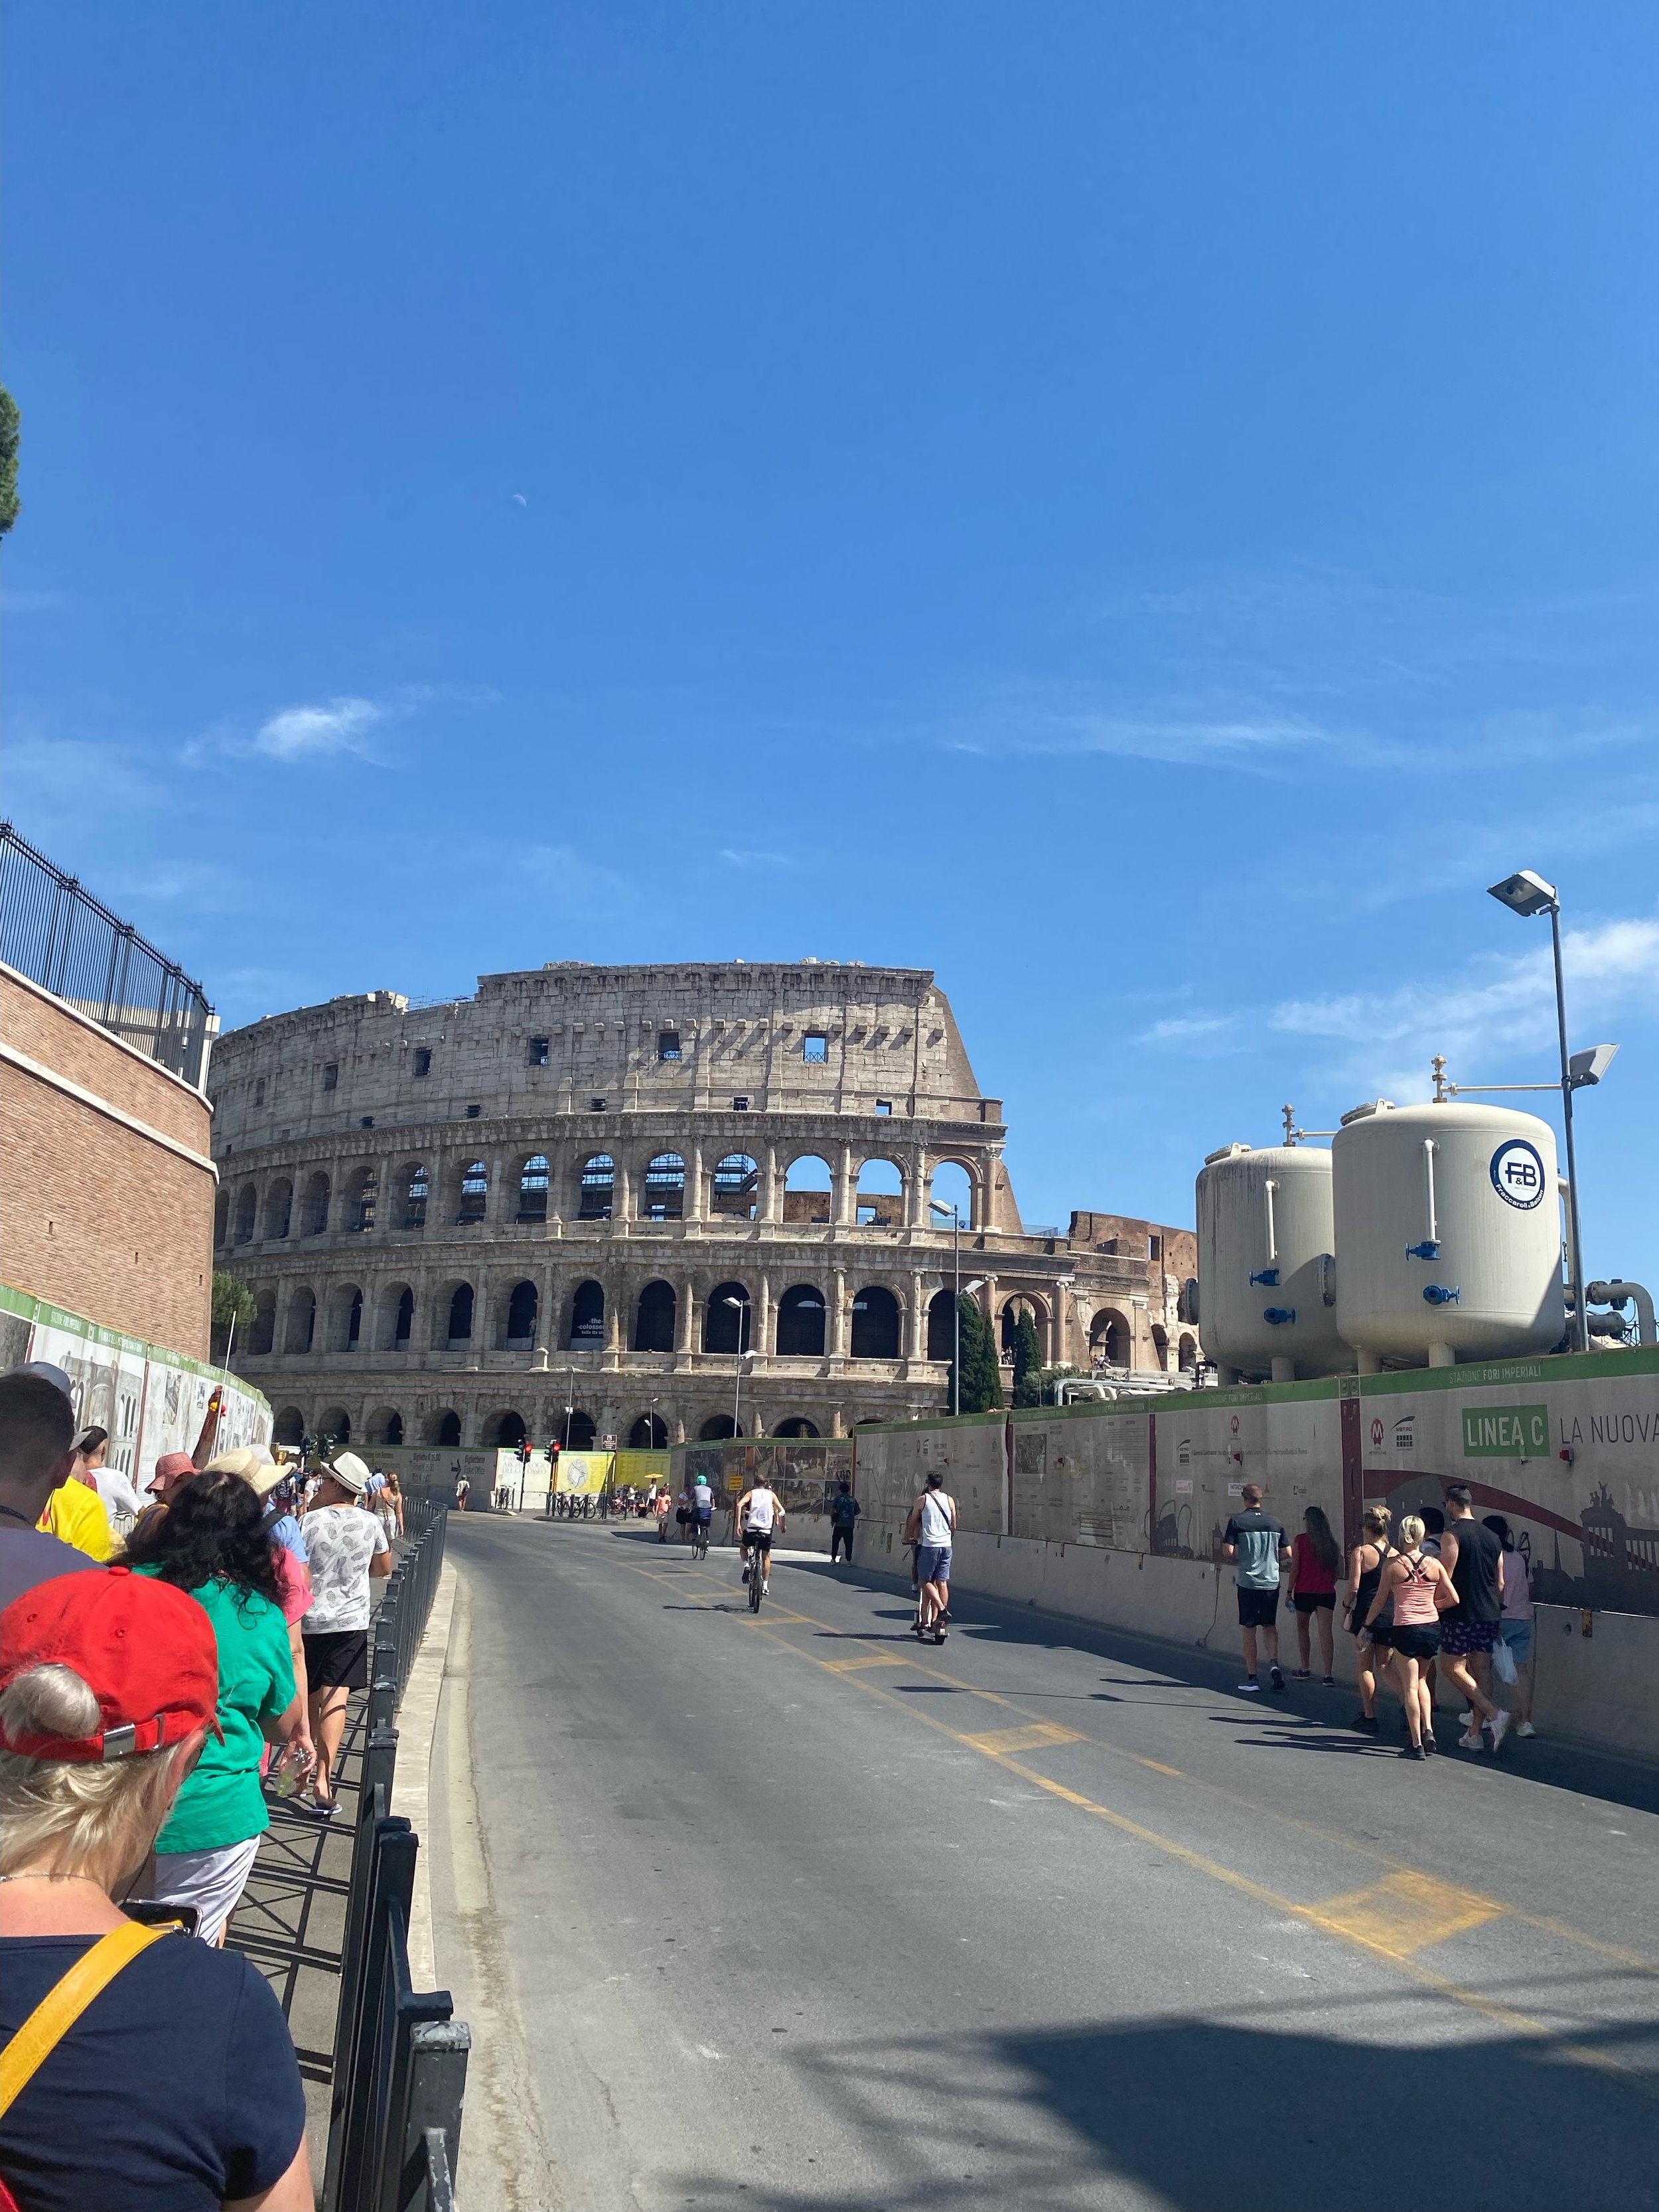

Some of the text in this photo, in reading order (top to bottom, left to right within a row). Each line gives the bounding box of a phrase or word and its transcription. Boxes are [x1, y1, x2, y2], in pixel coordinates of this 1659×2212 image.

[1449, 1365, 1542, 1384] STAZIONE FORI IMPERIALI
[1467, 1416, 1544, 1447] LINEA C
[1560, 1416, 1583, 1444] LA
